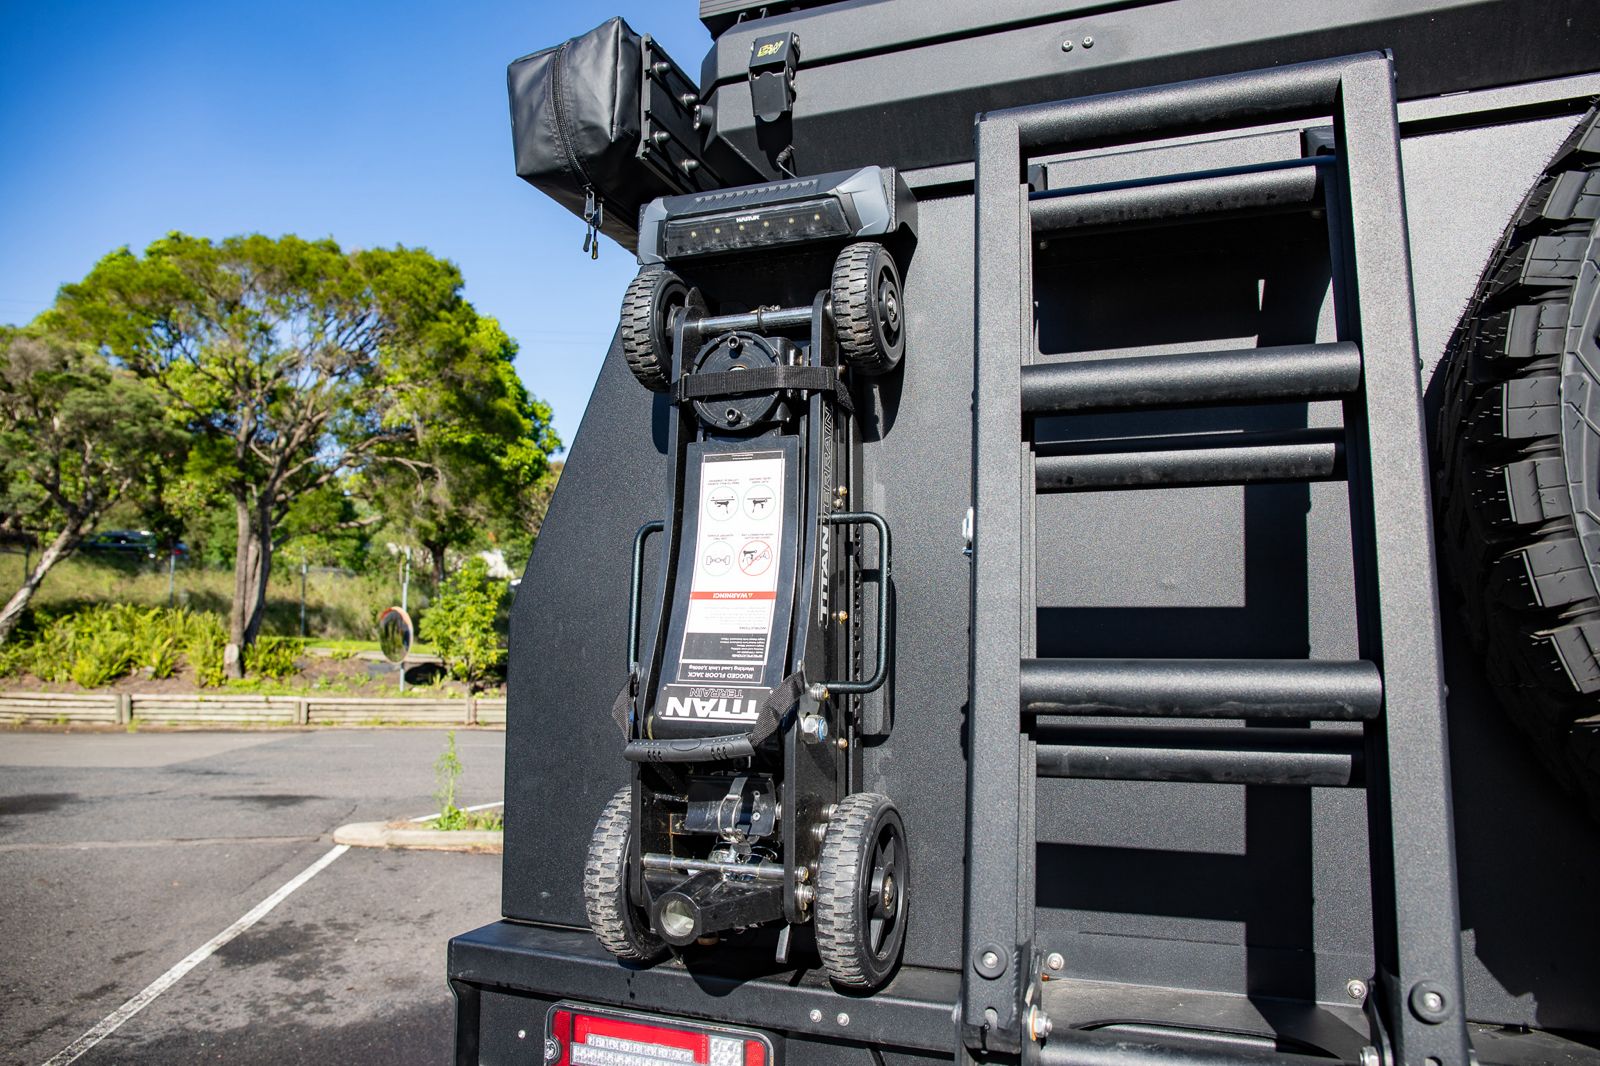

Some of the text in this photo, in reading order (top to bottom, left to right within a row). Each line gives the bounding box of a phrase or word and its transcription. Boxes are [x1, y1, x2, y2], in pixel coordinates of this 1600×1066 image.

[820, 526, 829, 621] TITAN
[689, 688, 743, 698] TERRAIN
[665, 697, 759, 720] TITAN
